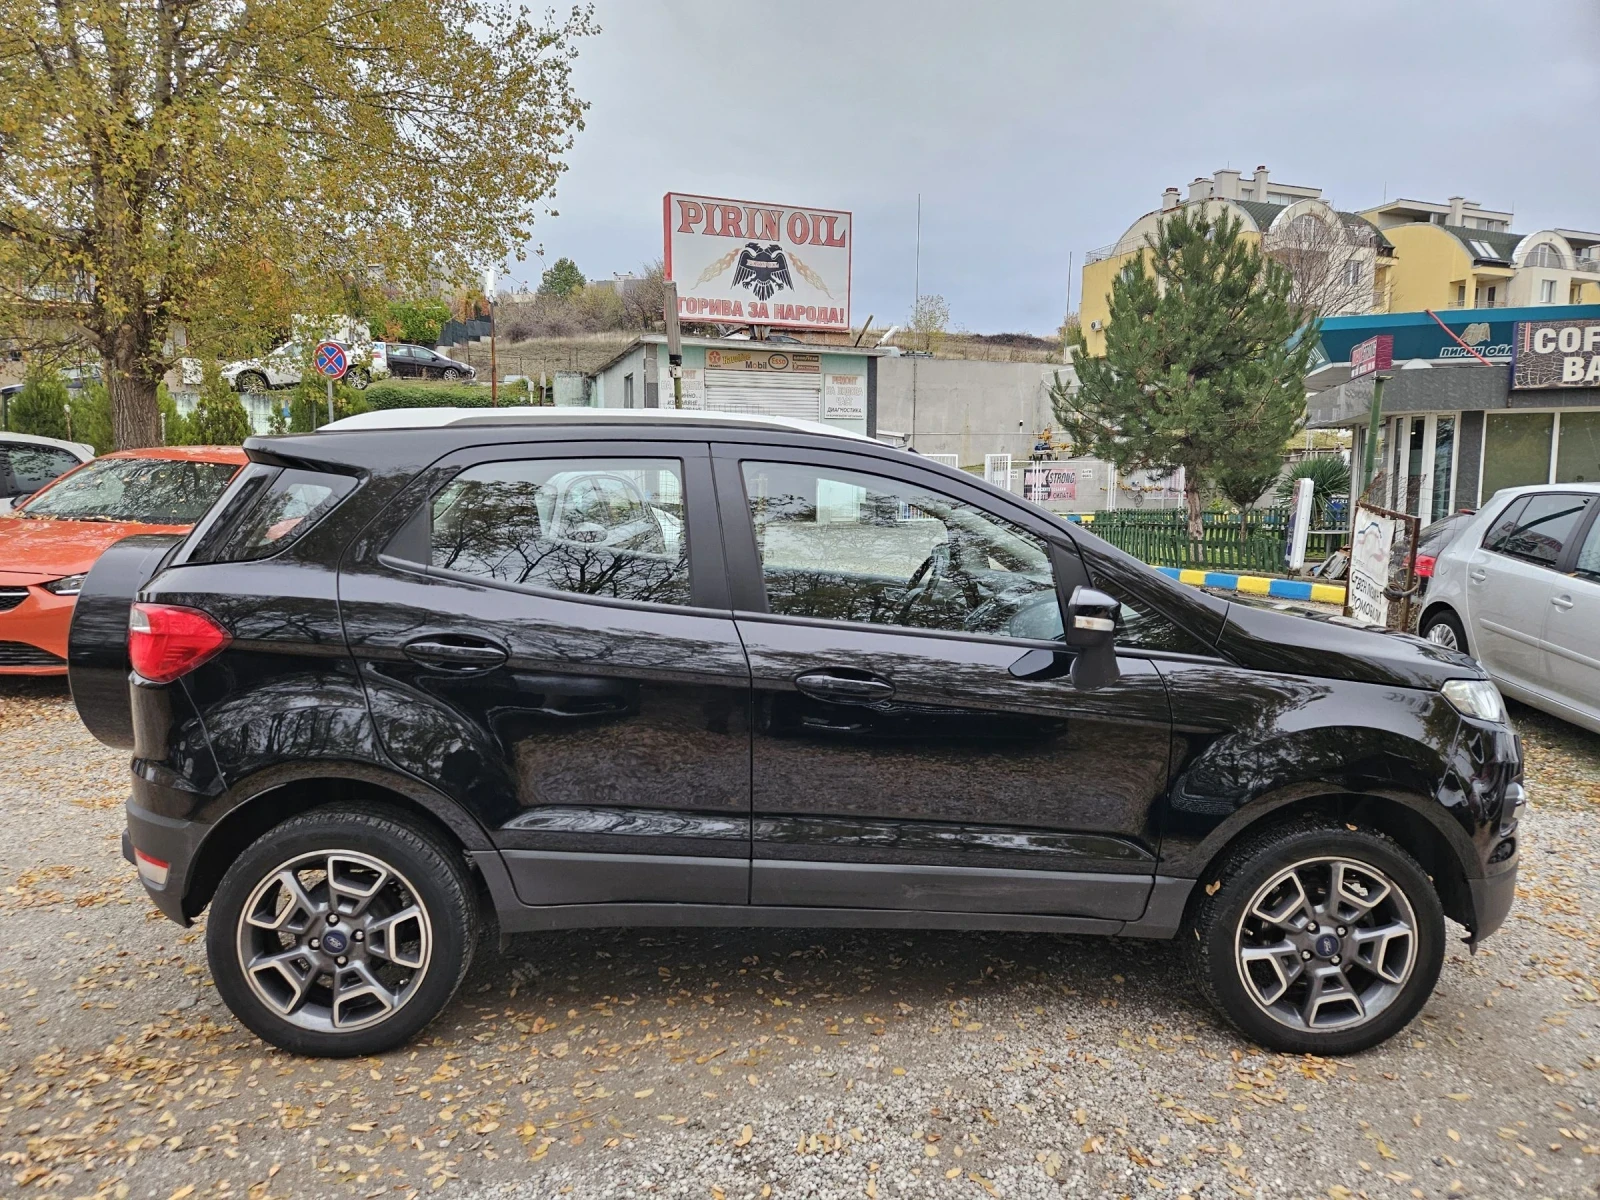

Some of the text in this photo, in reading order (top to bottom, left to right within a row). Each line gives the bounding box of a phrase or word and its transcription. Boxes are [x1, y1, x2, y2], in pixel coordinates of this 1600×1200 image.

[677, 200, 845, 247] PIRIN OIL
[677, 297, 844, 324] ГОРИВА ЗА НАРОДА!
[1439, 344, 1513, 358] ПИРИН ОЙЛ
[745, 361, 767, 369] Mobil
[771, 357, 785, 365] Esso
[1049, 472, 1076, 484] STRONG
